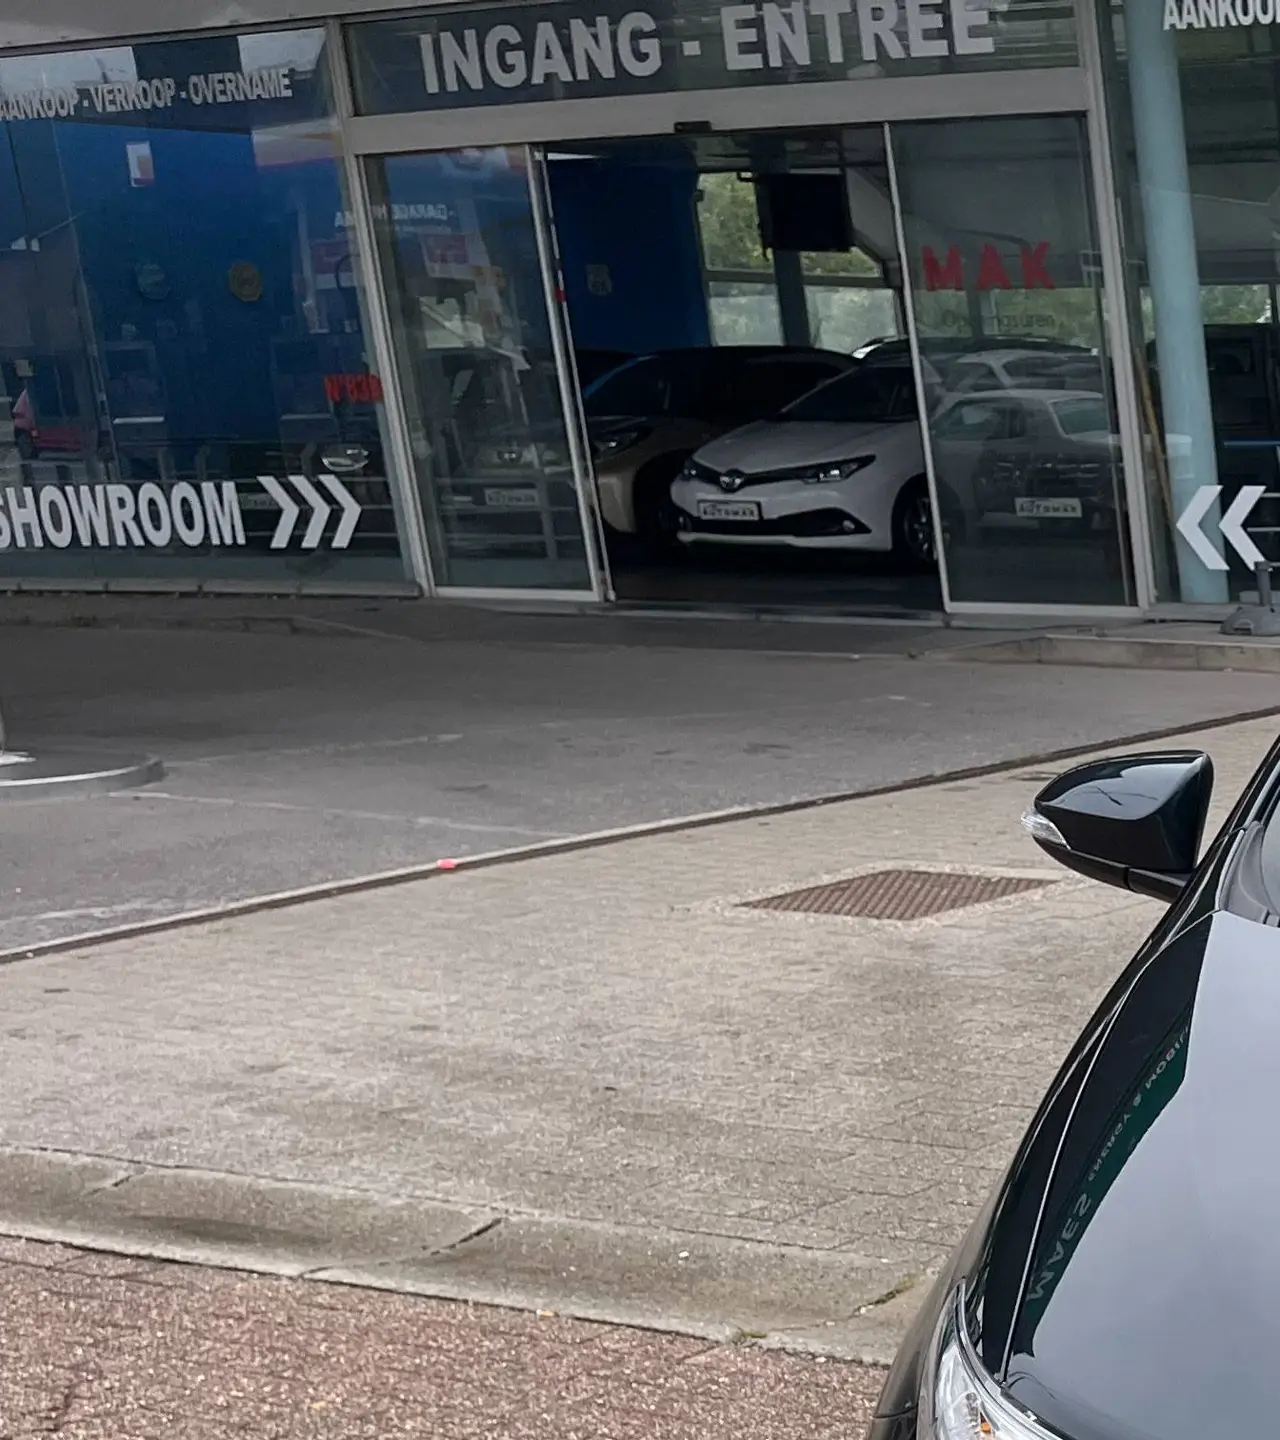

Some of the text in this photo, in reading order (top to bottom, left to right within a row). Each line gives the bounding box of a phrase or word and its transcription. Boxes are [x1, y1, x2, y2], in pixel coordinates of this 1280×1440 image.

[420, 12, 661, 95] INGANG
[721, 0, 995, 71] ENTREE
[89, 78, 176, 113] VERKOOP
[188, 67, 293, 105] OVERNAME
